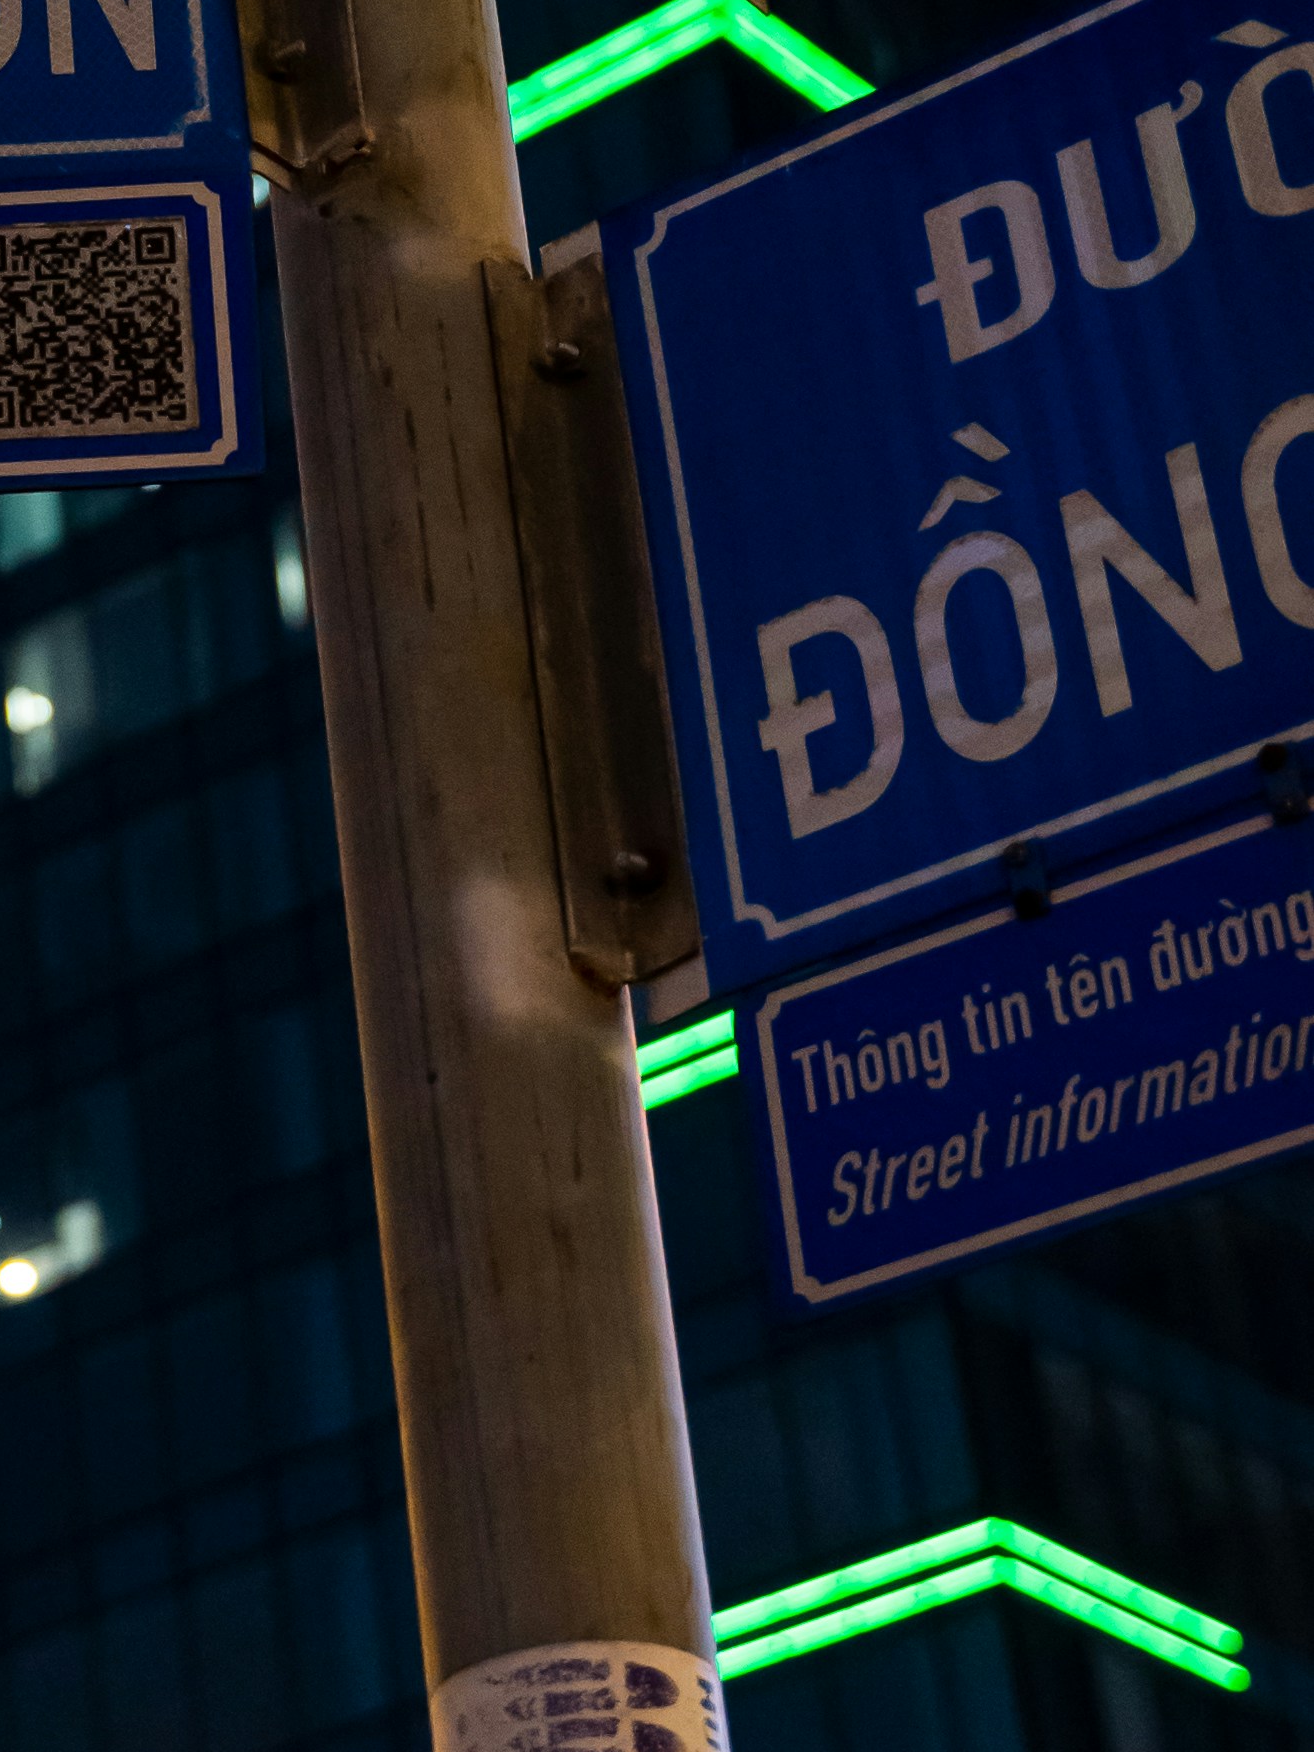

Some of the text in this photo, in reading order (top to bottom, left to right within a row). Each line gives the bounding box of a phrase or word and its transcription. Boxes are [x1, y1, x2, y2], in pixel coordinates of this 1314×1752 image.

[791, 1028, 951, 1113] Thông
[961, 983, 1033, 1055] tin
[1045, 953, 1133, 1026] tên
[827, 1110, 989, 1227] Street
